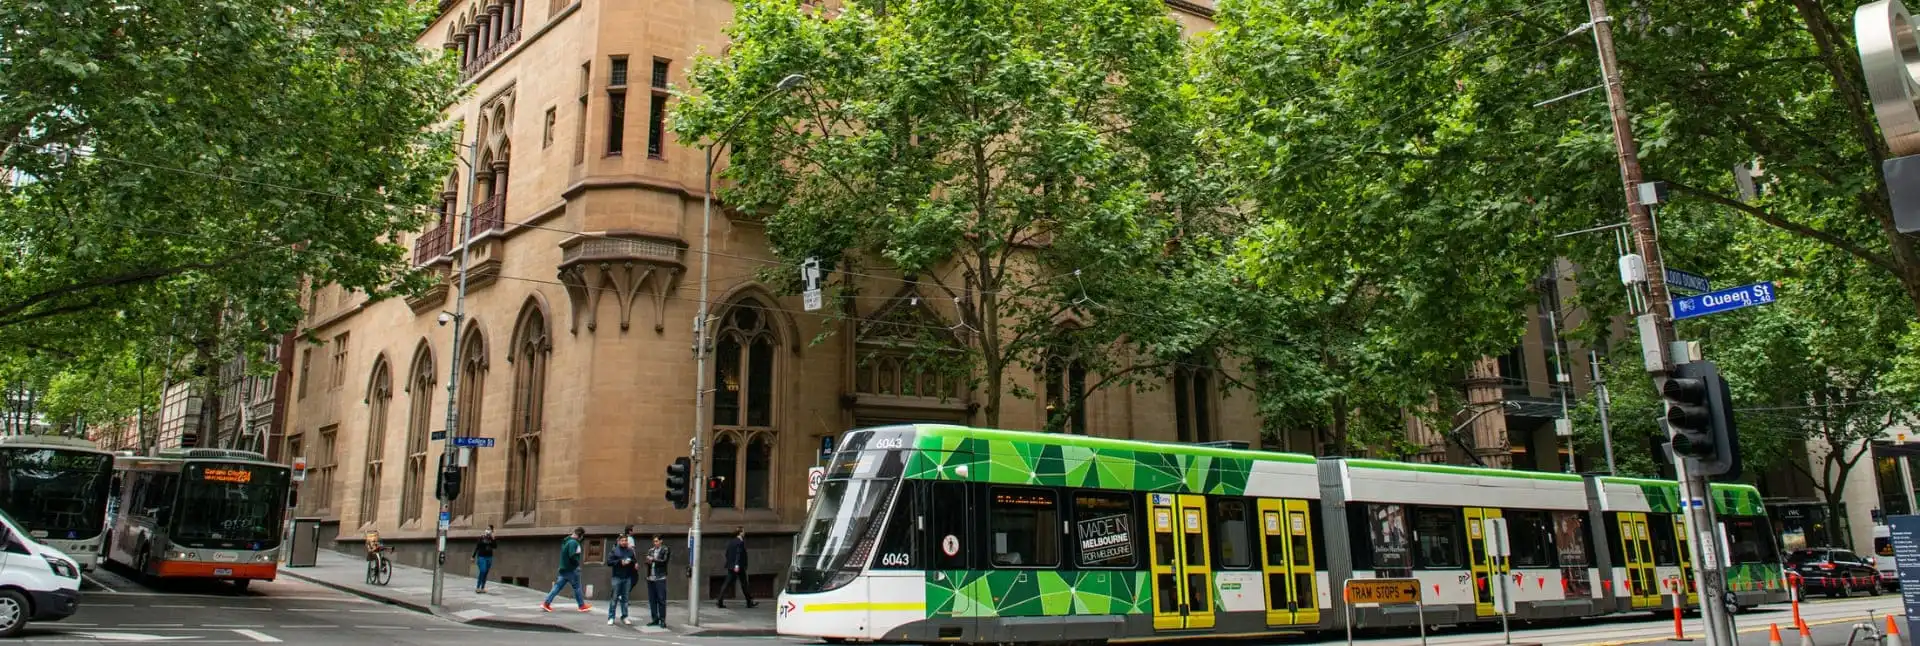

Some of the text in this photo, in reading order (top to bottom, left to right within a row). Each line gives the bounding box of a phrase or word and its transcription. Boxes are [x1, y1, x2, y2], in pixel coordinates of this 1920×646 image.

[1702, 284, 1770, 307] Queen St
[876, 438, 902, 449] 6043
[809, 475, 823, 486] 40
[1079, 517, 1128, 539] MADE IN
[1082, 532, 1128, 549] MELBOURNE
[882, 553, 910, 566] 6043
[1084, 545, 1130, 561] FOR MELBOURNE
[1351, 585, 1400, 599] TRAM STOPS
